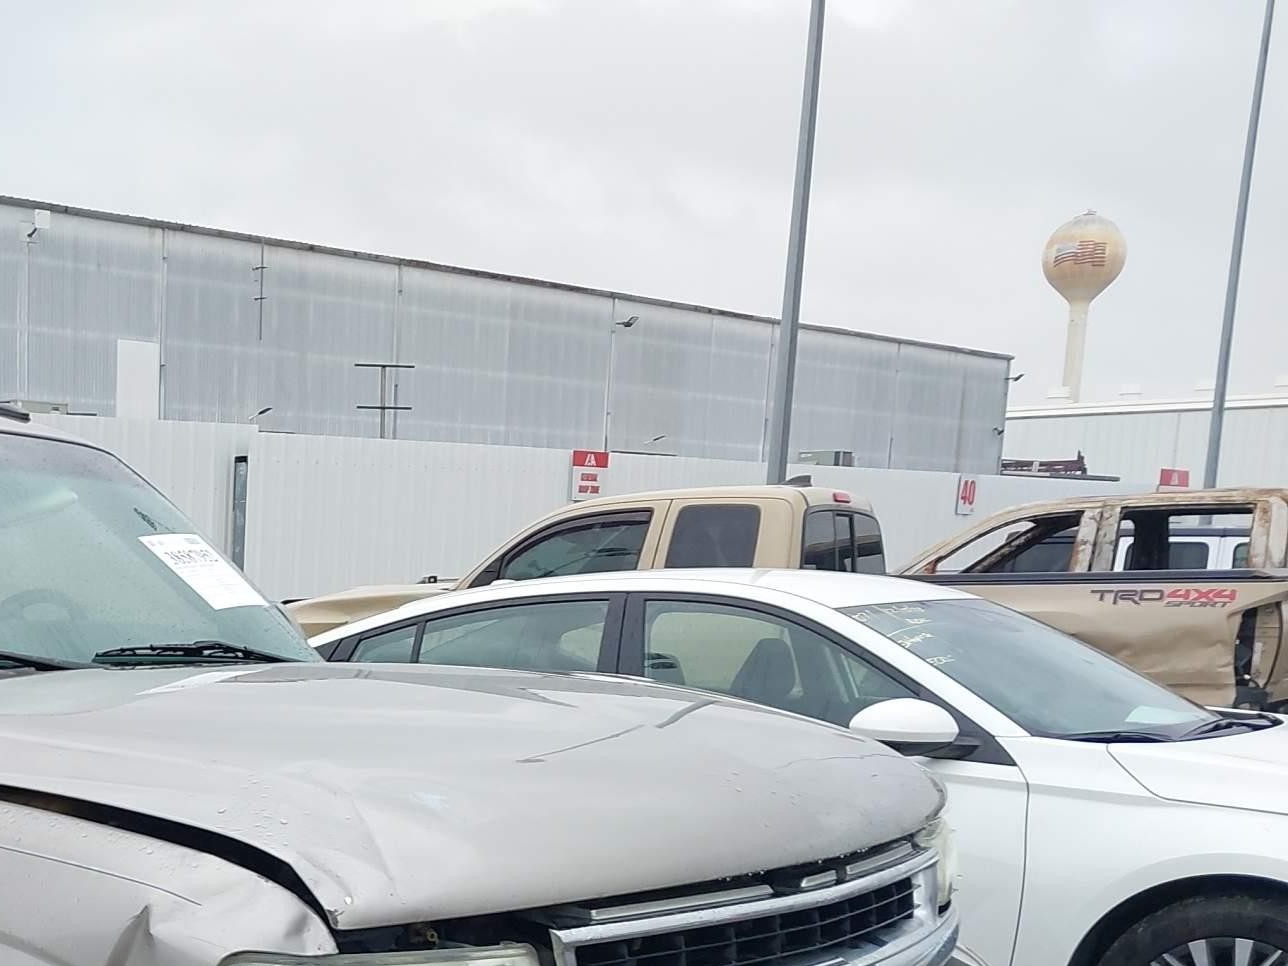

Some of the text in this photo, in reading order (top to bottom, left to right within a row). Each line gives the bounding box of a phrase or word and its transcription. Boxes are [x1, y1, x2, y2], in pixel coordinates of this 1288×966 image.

[960, 479, 977, 506] 40
[1090, 589, 1164, 605] TRD
[1164, 600, 1231, 608] SPORT
